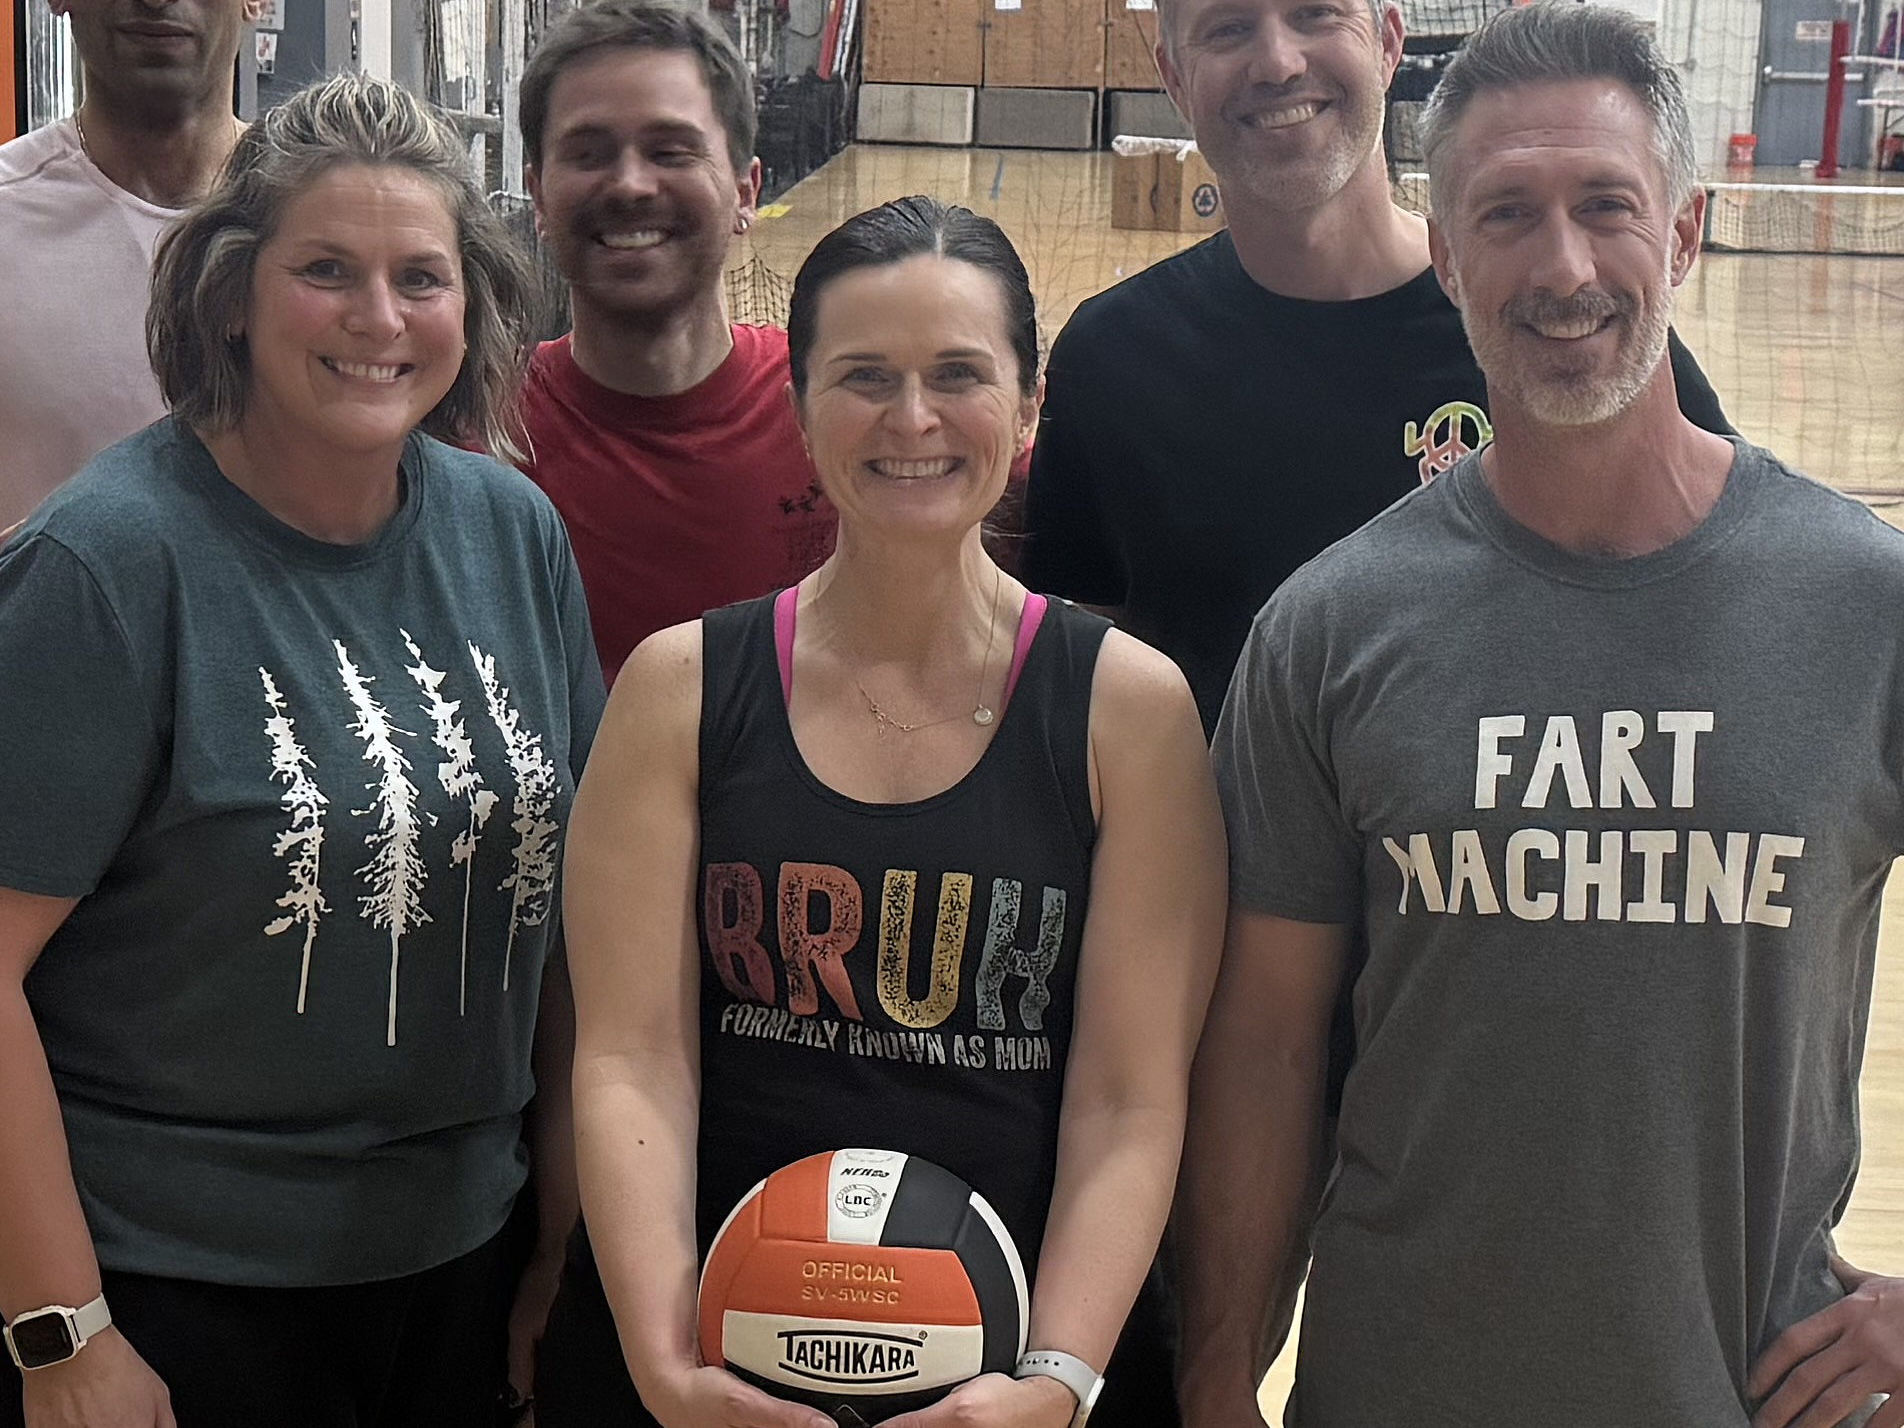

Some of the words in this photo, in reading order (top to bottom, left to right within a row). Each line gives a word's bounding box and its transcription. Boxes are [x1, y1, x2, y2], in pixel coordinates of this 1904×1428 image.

[1474, 710, 1715, 809] FART
[1382, 828, 1806, 928] MACHINE
[704, 861, 1067, 1031] BRUH
[720, 1003, 840, 1053] FORMERLY
[848, 1023, 946, 1066] KNOWN
[954, 1034, 987, 1070] AS
[995, 1036, 1052, 1071] MOM
[801, 1259, 902, 1285] OFFICIAL
[777, 1329, 923, 1374] TACHIKARA
